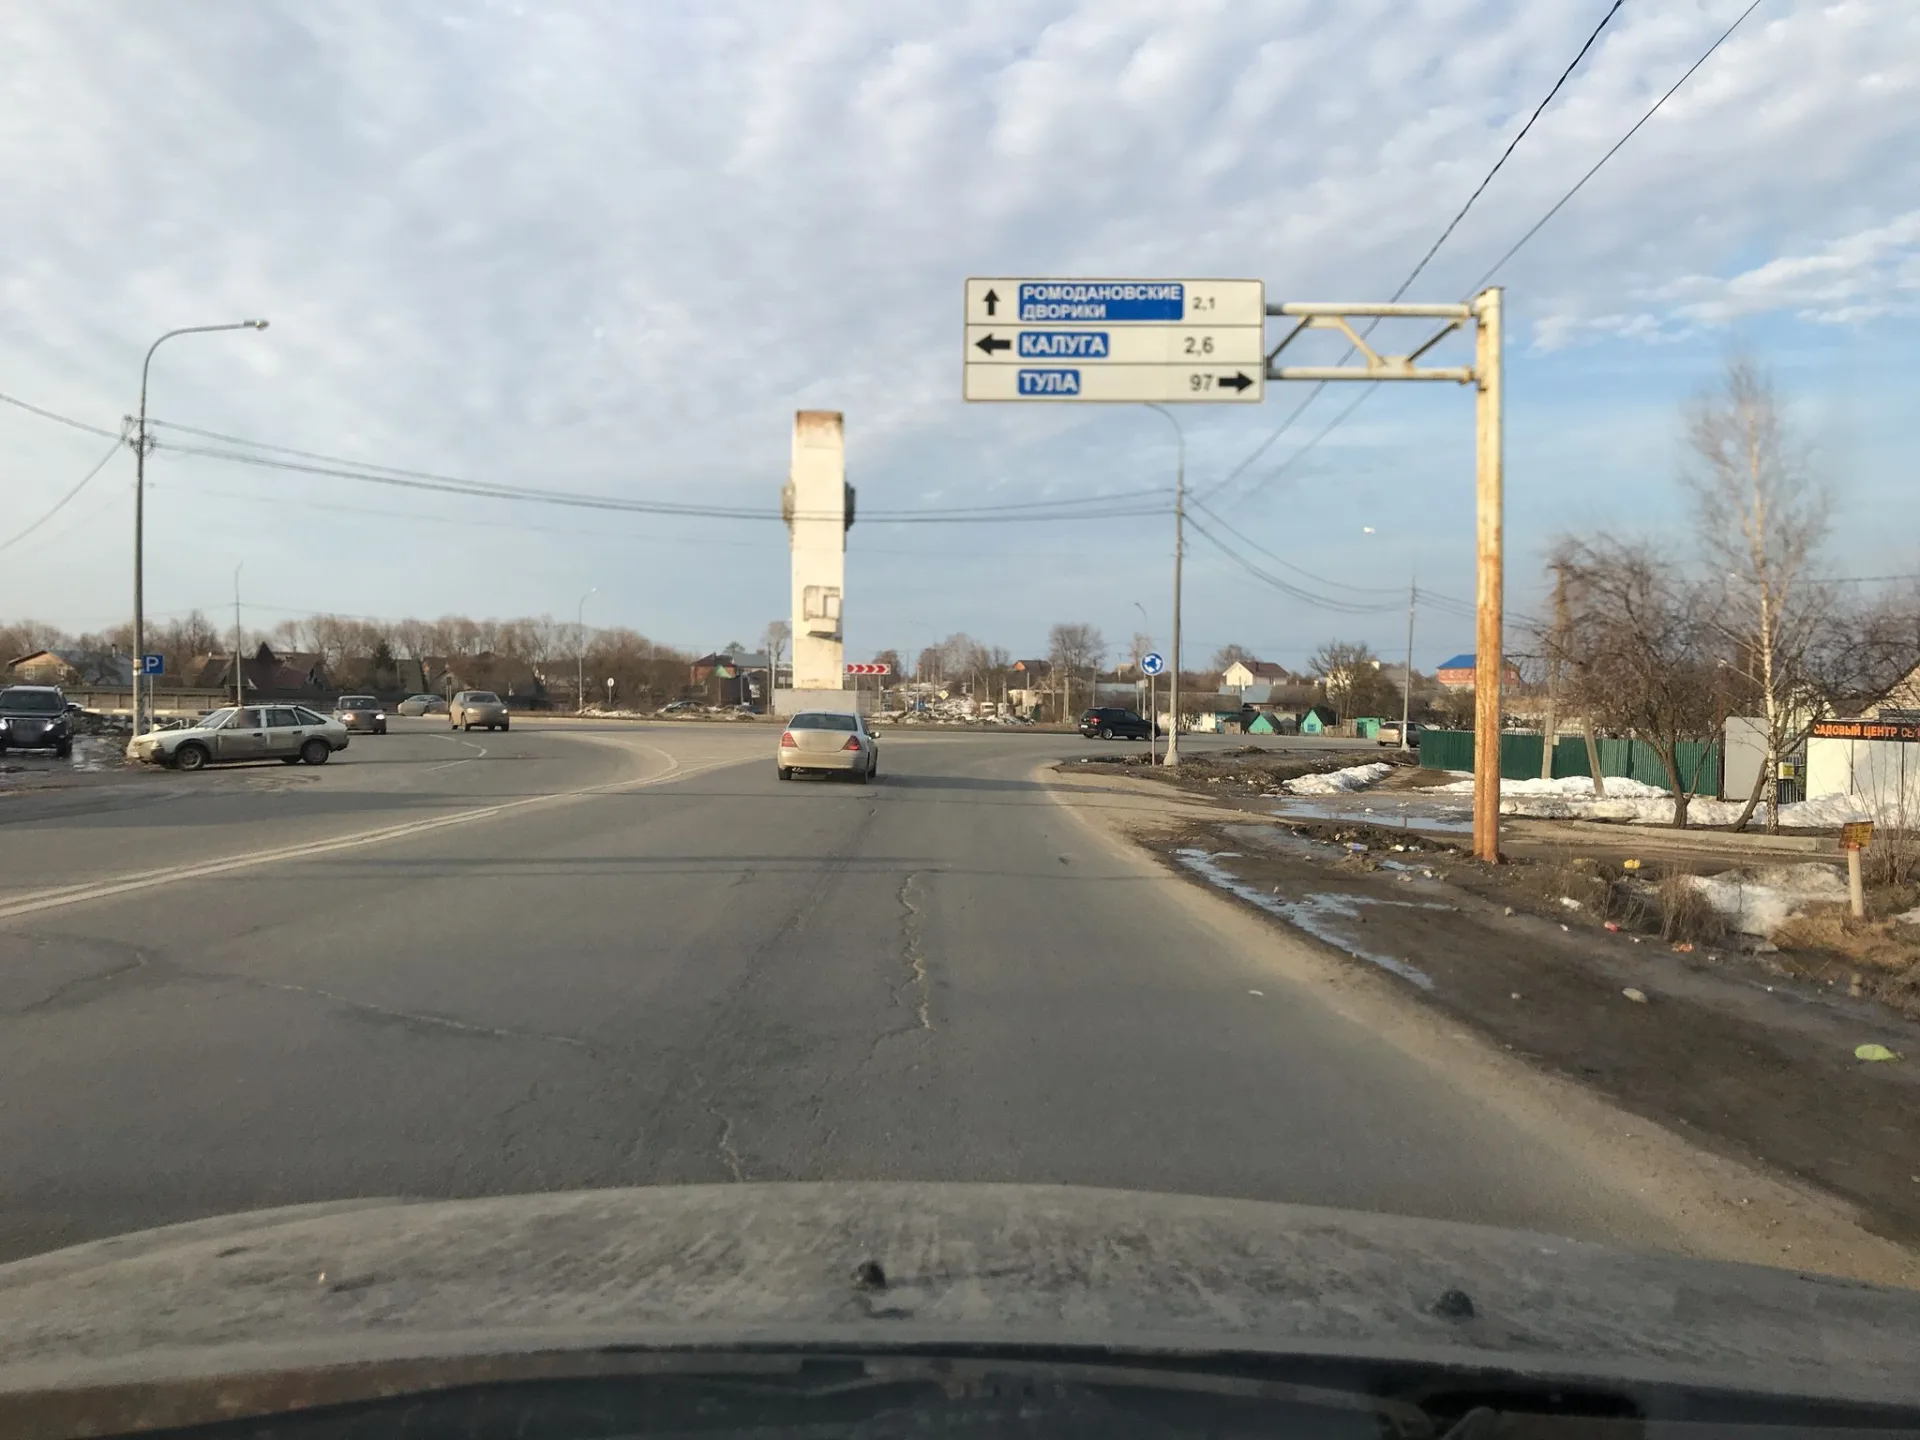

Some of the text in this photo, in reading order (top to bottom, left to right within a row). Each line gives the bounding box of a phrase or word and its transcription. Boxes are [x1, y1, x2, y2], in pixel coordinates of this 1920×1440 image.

[1023, 285, 1181, 302] РОМОДАНОВСКИЕ
[1022, 303, 1107, 320] ДВОРИКИ
[1192, 296, 1215, 311] 2,1
[1022, 335, 1214, 355] КАЛУГА 2,6
[1021, 373, 1214, 392] ТУЛА 97
[146, 656, 160, 672] P
[1814, 724, 1861, 736] САДОВЫЙ
[1863, 725, 1898, 738] ЦЕНТР
